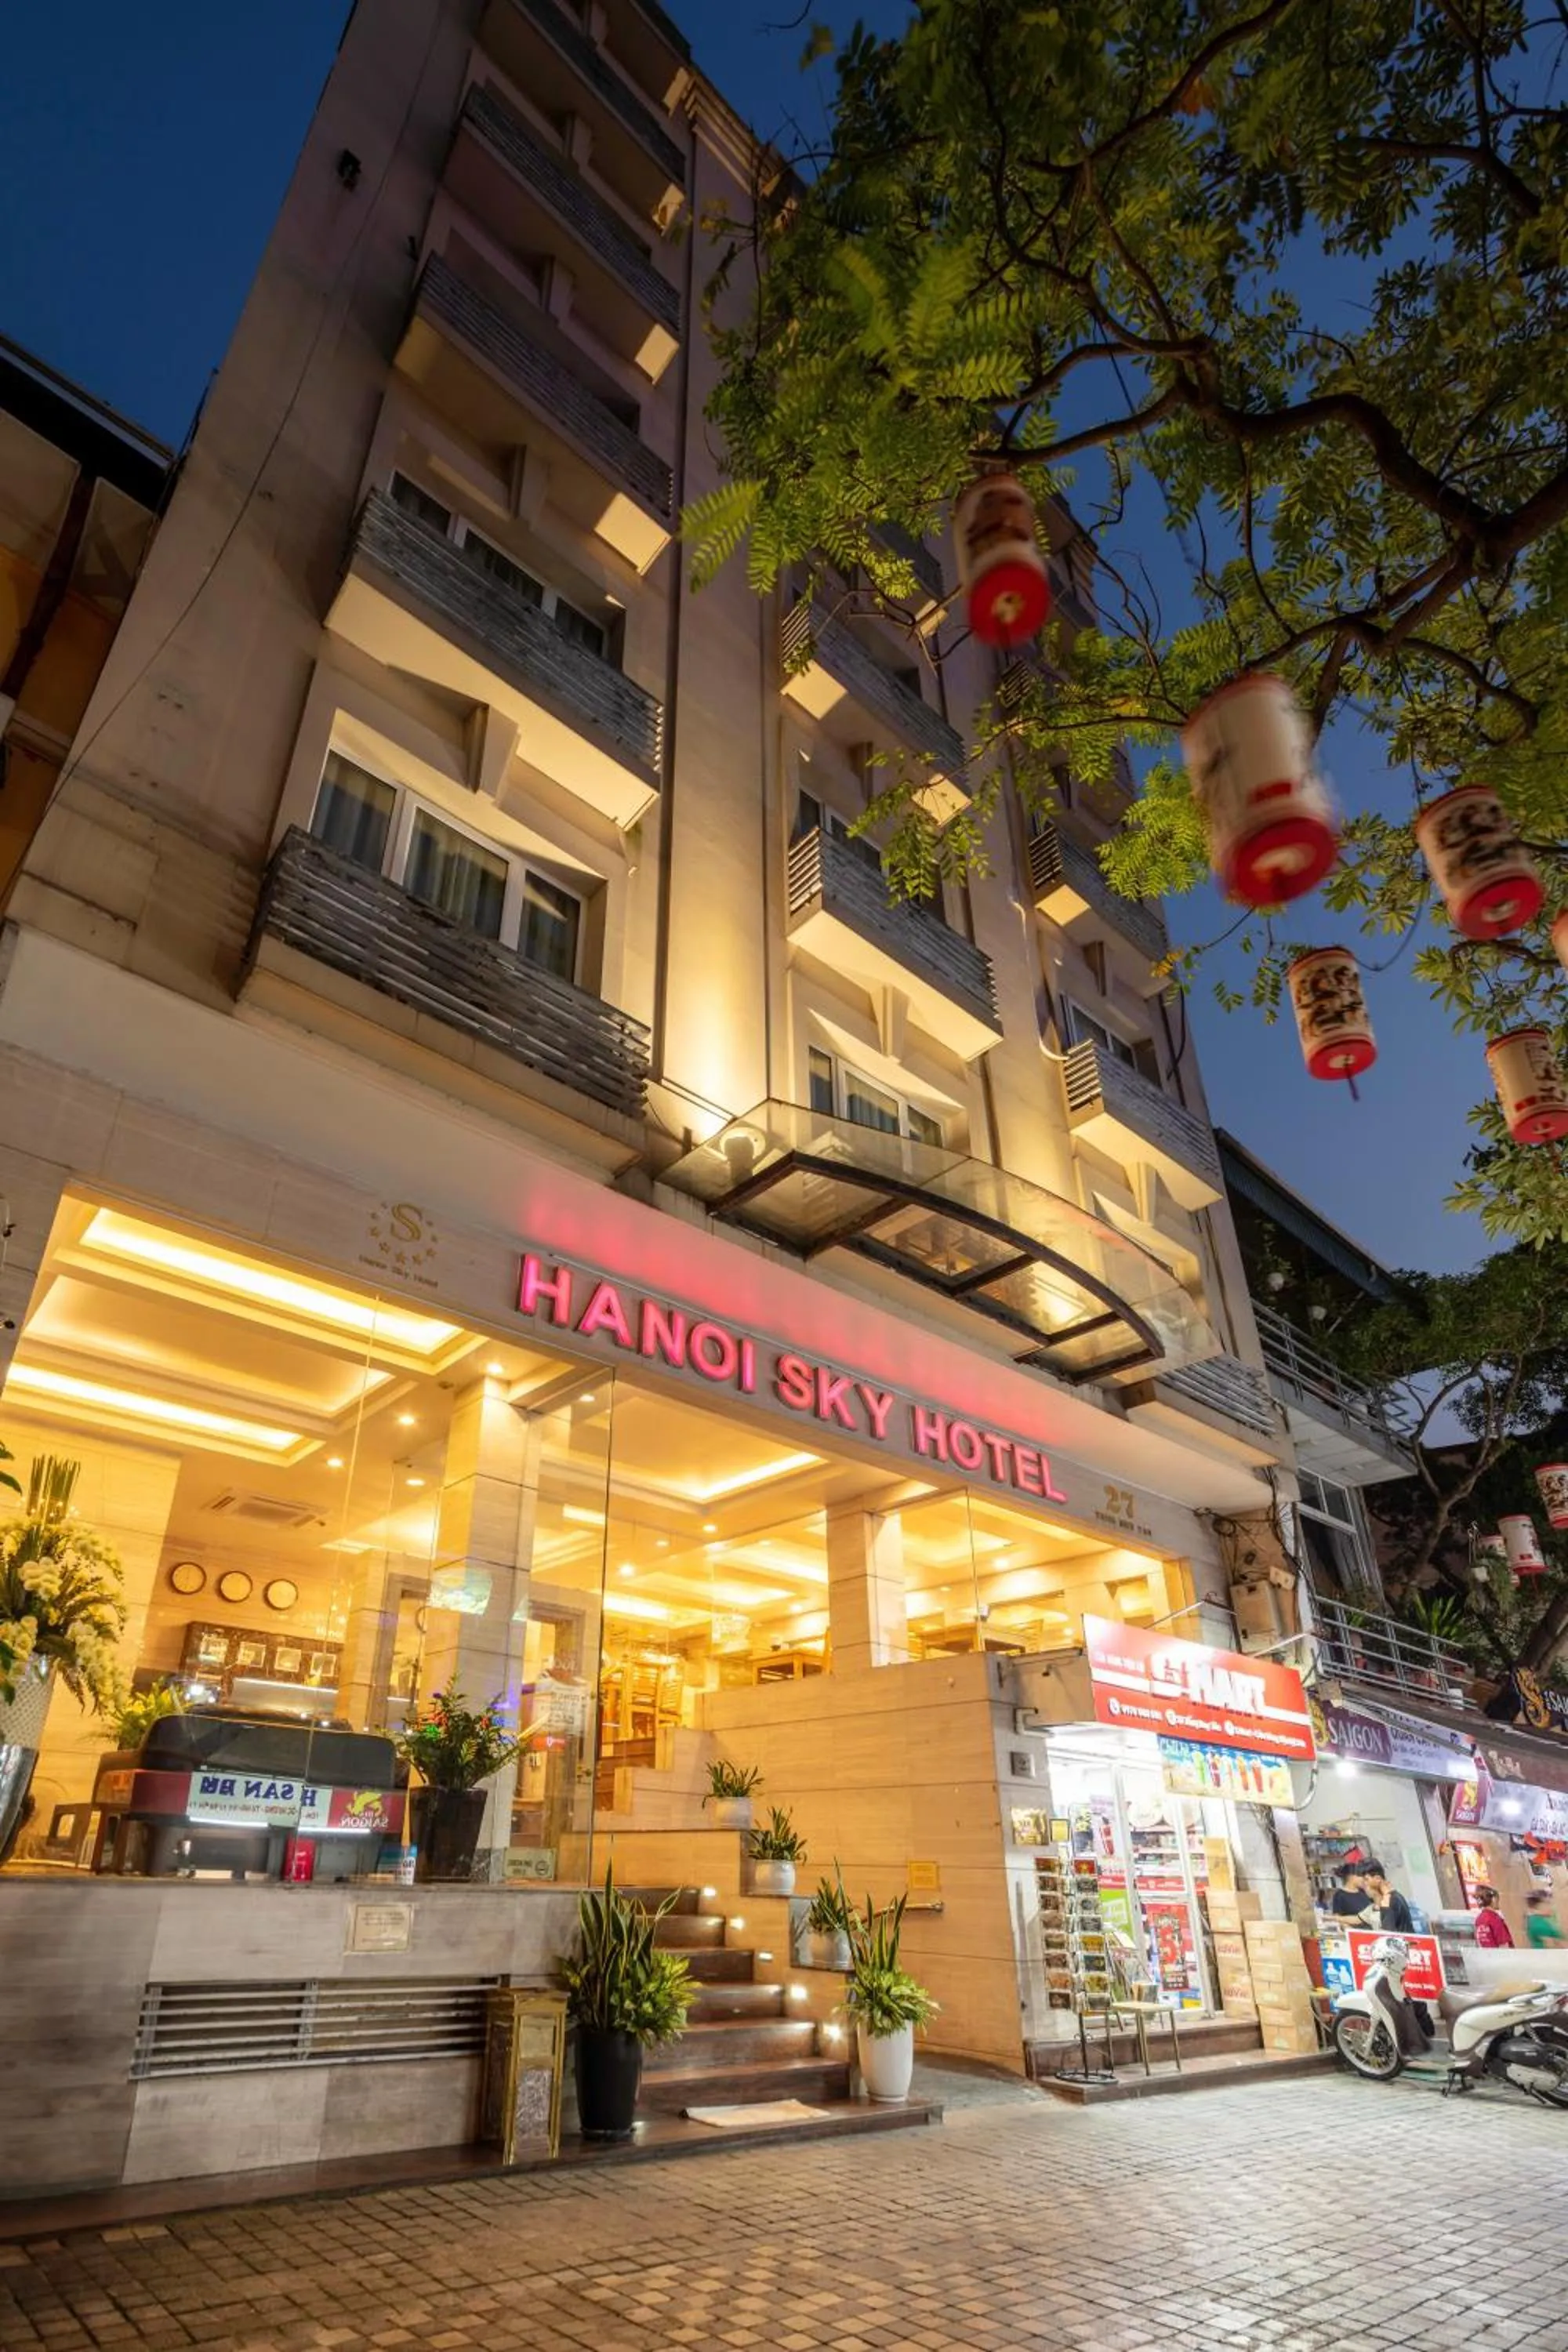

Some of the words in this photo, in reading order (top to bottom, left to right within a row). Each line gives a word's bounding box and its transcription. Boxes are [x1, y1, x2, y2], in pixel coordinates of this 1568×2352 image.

[515, 1254, 757, 1395] HANOI
[776, 1353, 894, 1440] SKY
[909, 1404, 1068, 1504] HOTEL
[1327, 1716, 1385, 1755] SAIGON
